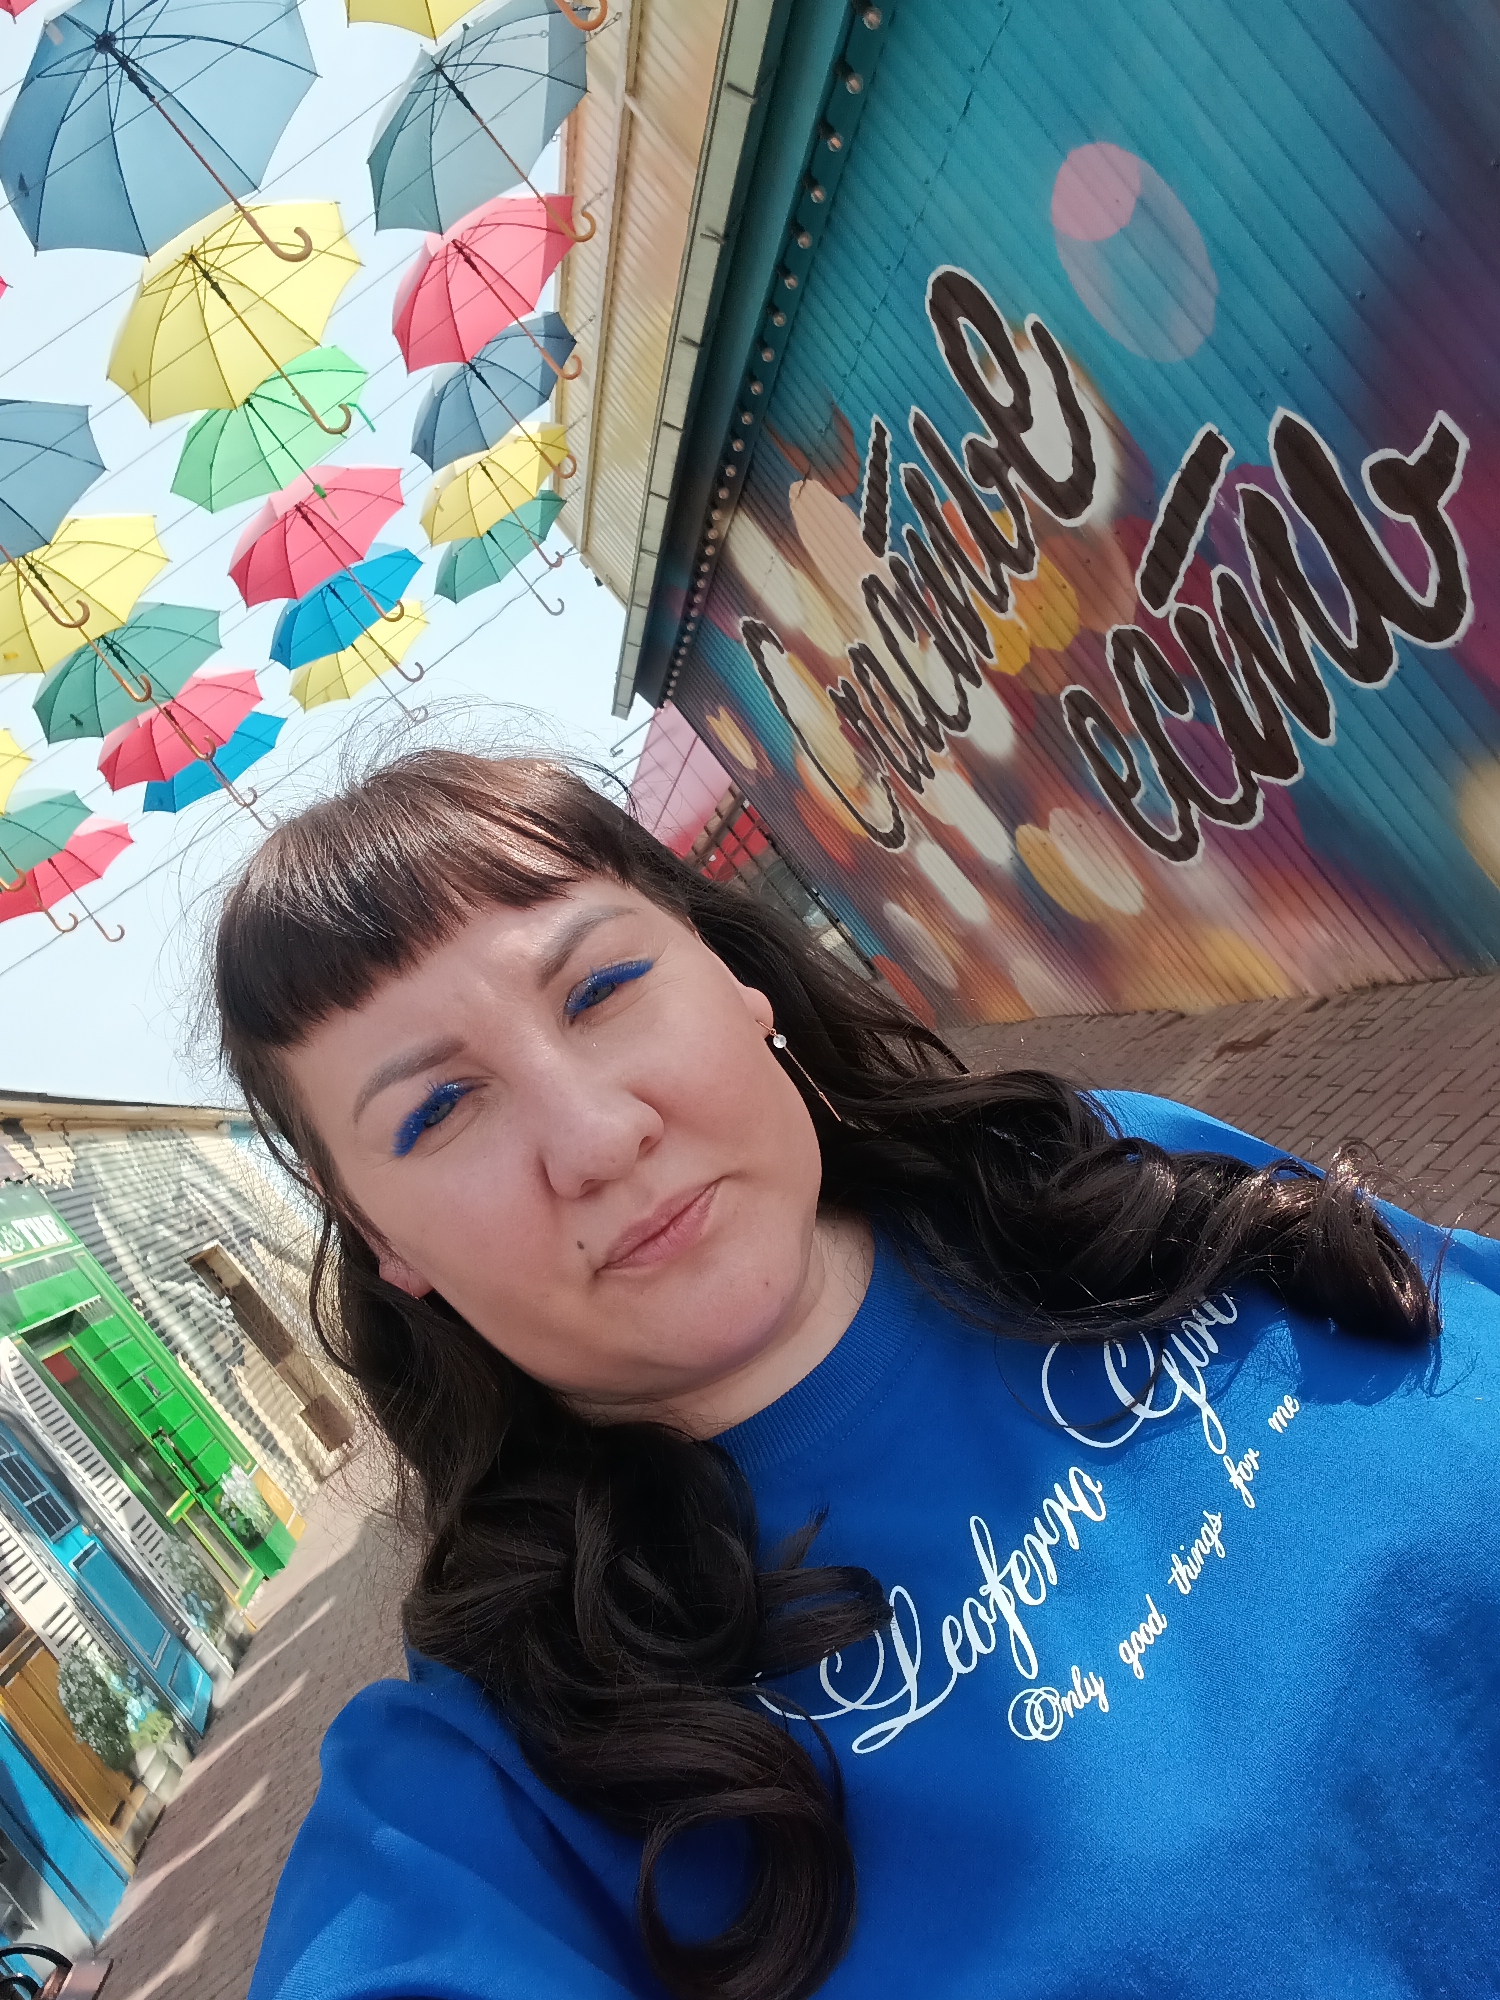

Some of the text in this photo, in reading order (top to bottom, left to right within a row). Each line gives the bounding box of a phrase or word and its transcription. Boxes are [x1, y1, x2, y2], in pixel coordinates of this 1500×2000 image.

[740, 265, 1097, 852] Счастье
[1061, 406, 1474, 863] есть
[752, 1466, 1106, 1754] Leoferro
[1008, 1395, 1299, 1741] Only good things for me
